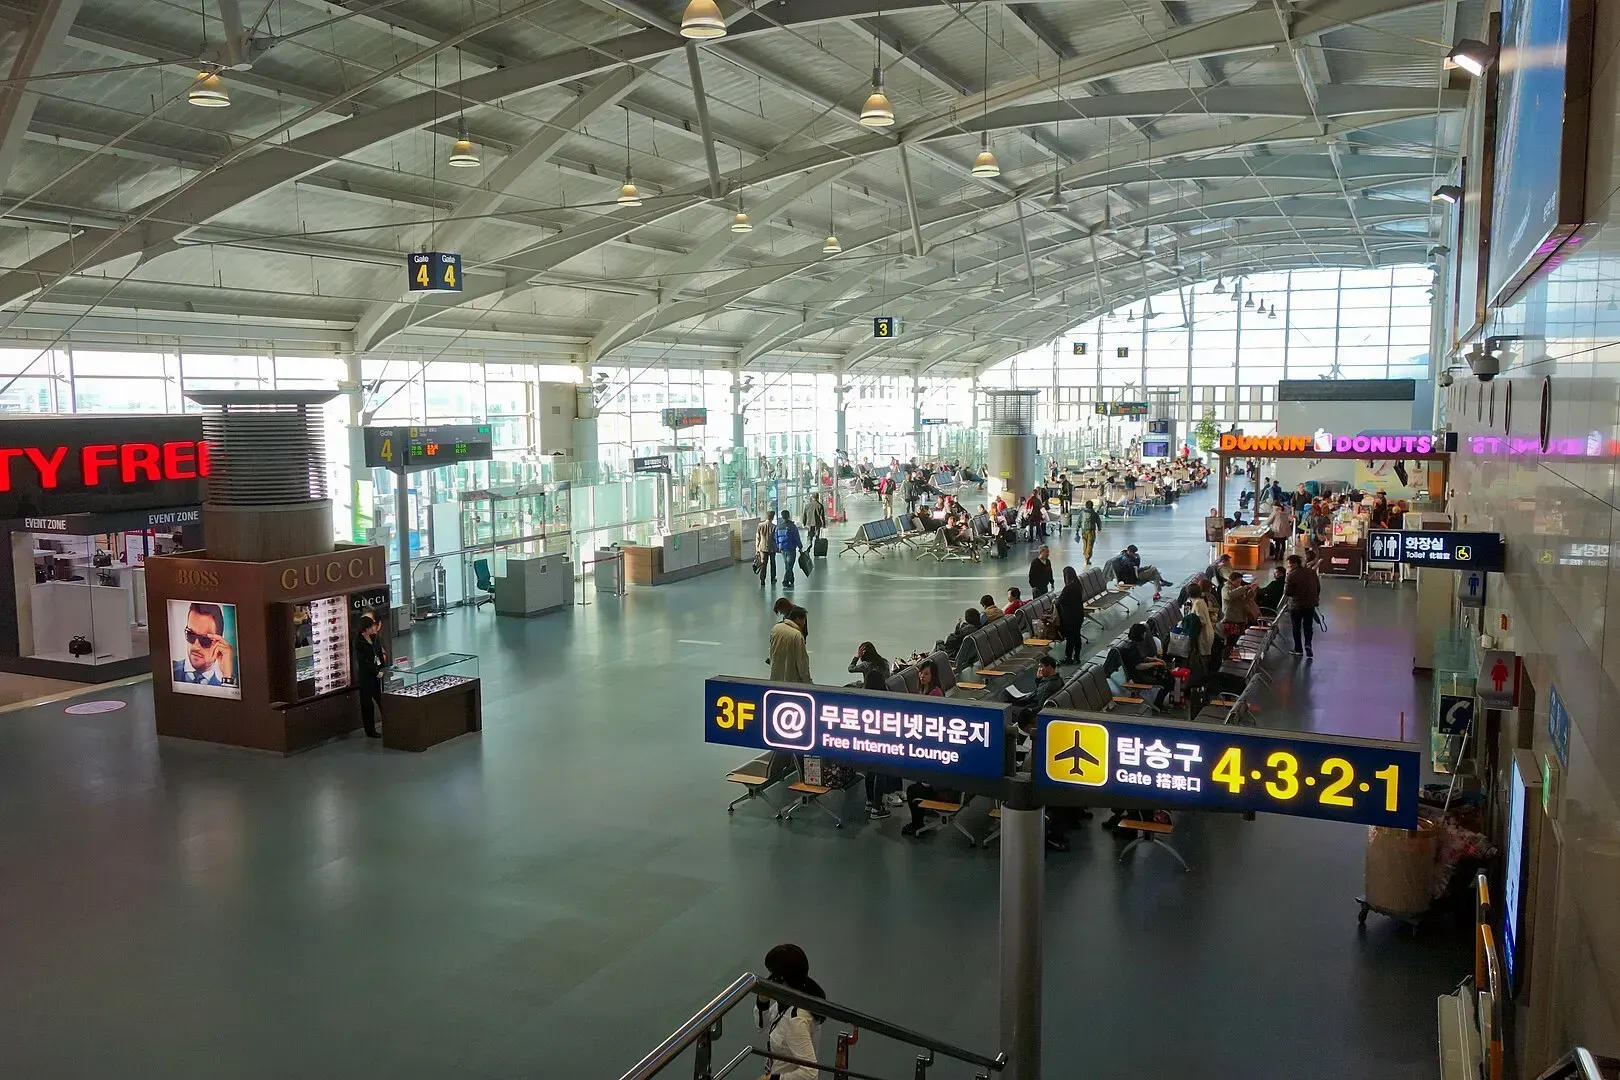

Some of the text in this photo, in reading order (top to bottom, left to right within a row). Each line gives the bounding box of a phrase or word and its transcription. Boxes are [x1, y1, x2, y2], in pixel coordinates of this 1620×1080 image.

[442, 255, 455, 263] Gate
[417, 264, 429, 287] 4
[444, 265, 455, 287] 4
[879, 323, 888, 336] 3
[1076, 346, 1083, 354] 2
[668, 413, 674, 424] 3
[380, 429, 393, 437] Gate
[381, 439, 392, 462] 4
[1336, 434, 1431, 453] DONUTS
[25, 517, 66, 531] EVENT ZONE
[149, 511, 199, 525] EVENT ZONE
[1405, 536, 1444, 551] 화장실
[1406, 551, 1426, 559] Toilet
[176, 569, 220, 587] BOSS
[281, 557, 375, 590] GUCCI
[354, 596, 385, 609] GUCCI
[716, 696, 756, 730] 3F
[819, 704, 990, 748] 무료인터넷라운지
[822, 733, 960, 765] Free Internet Lounge
[1116, 737, 1203, 773] 탑승구
[1115, 768, 1152, 786] Gate
